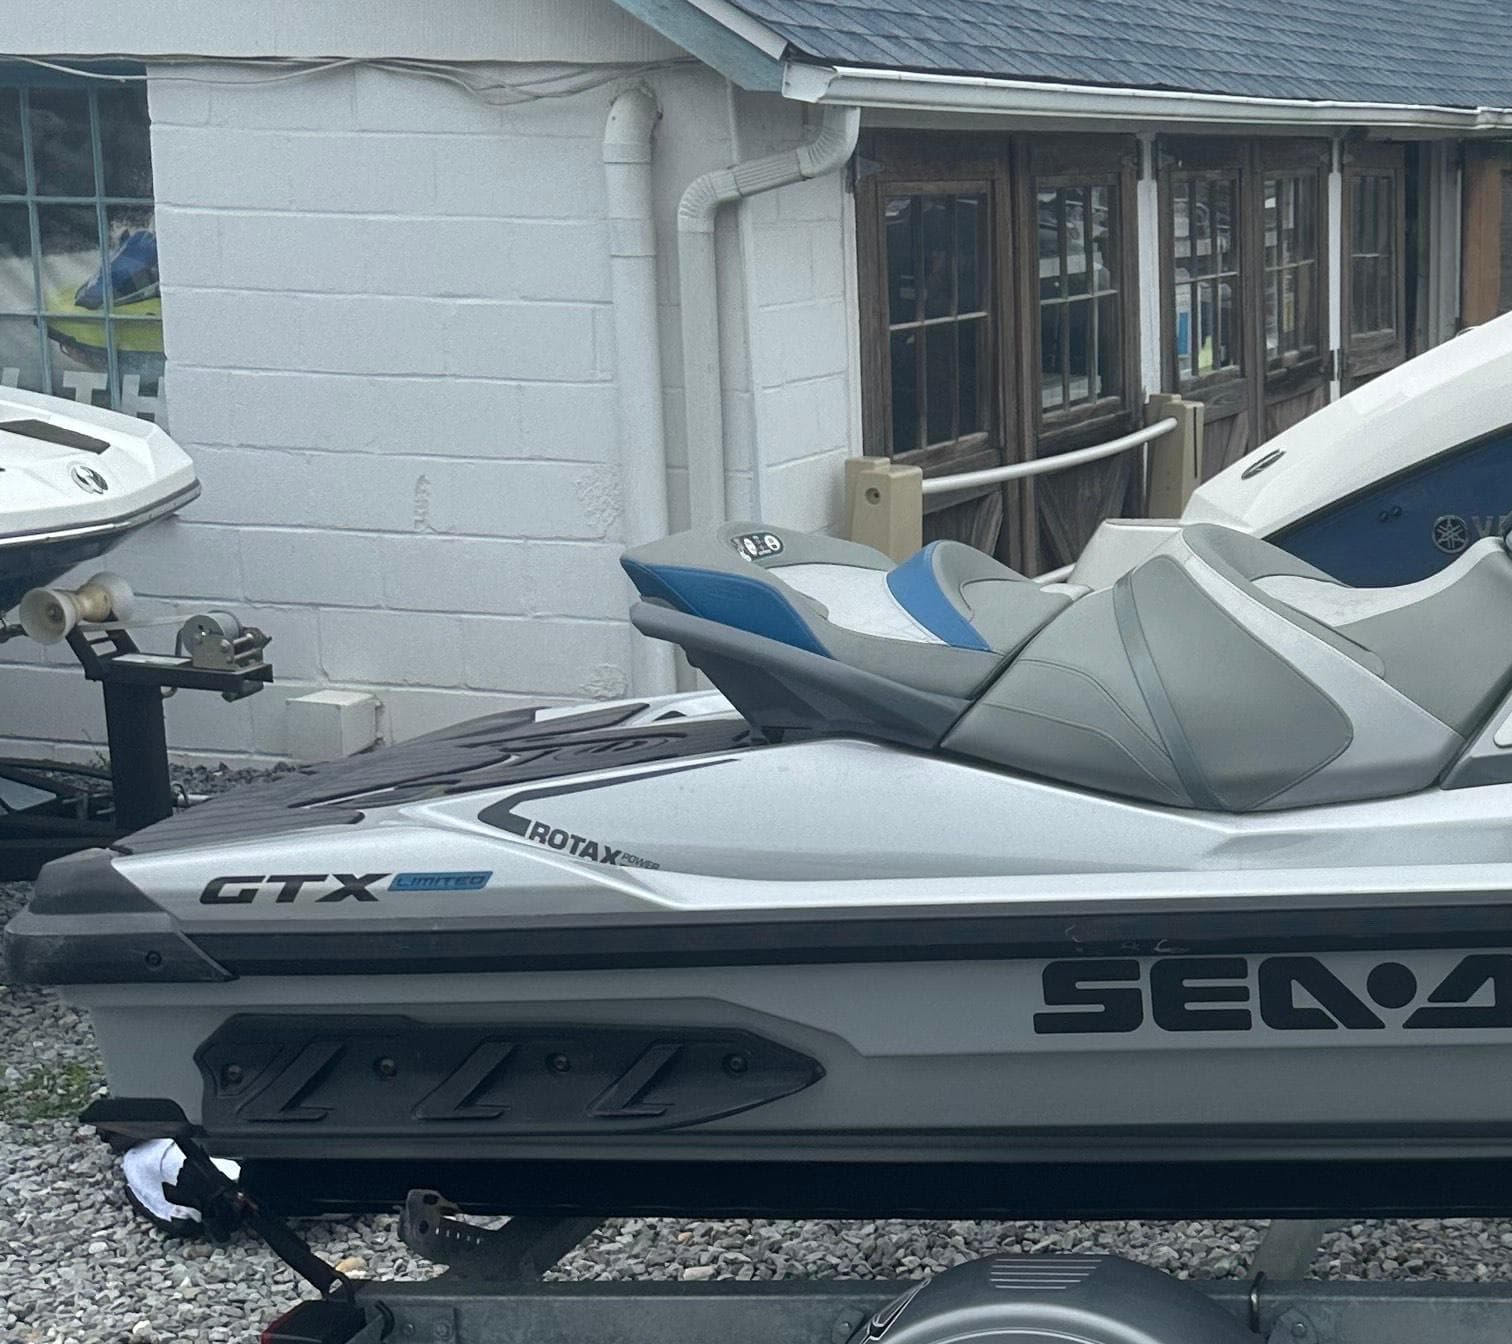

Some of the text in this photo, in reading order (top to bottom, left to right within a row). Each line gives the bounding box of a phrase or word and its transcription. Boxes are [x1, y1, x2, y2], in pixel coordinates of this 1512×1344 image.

[528, 820, 660, 870] ROTAX POWER
[199, 872, 486, 905] GTX LIMITED
